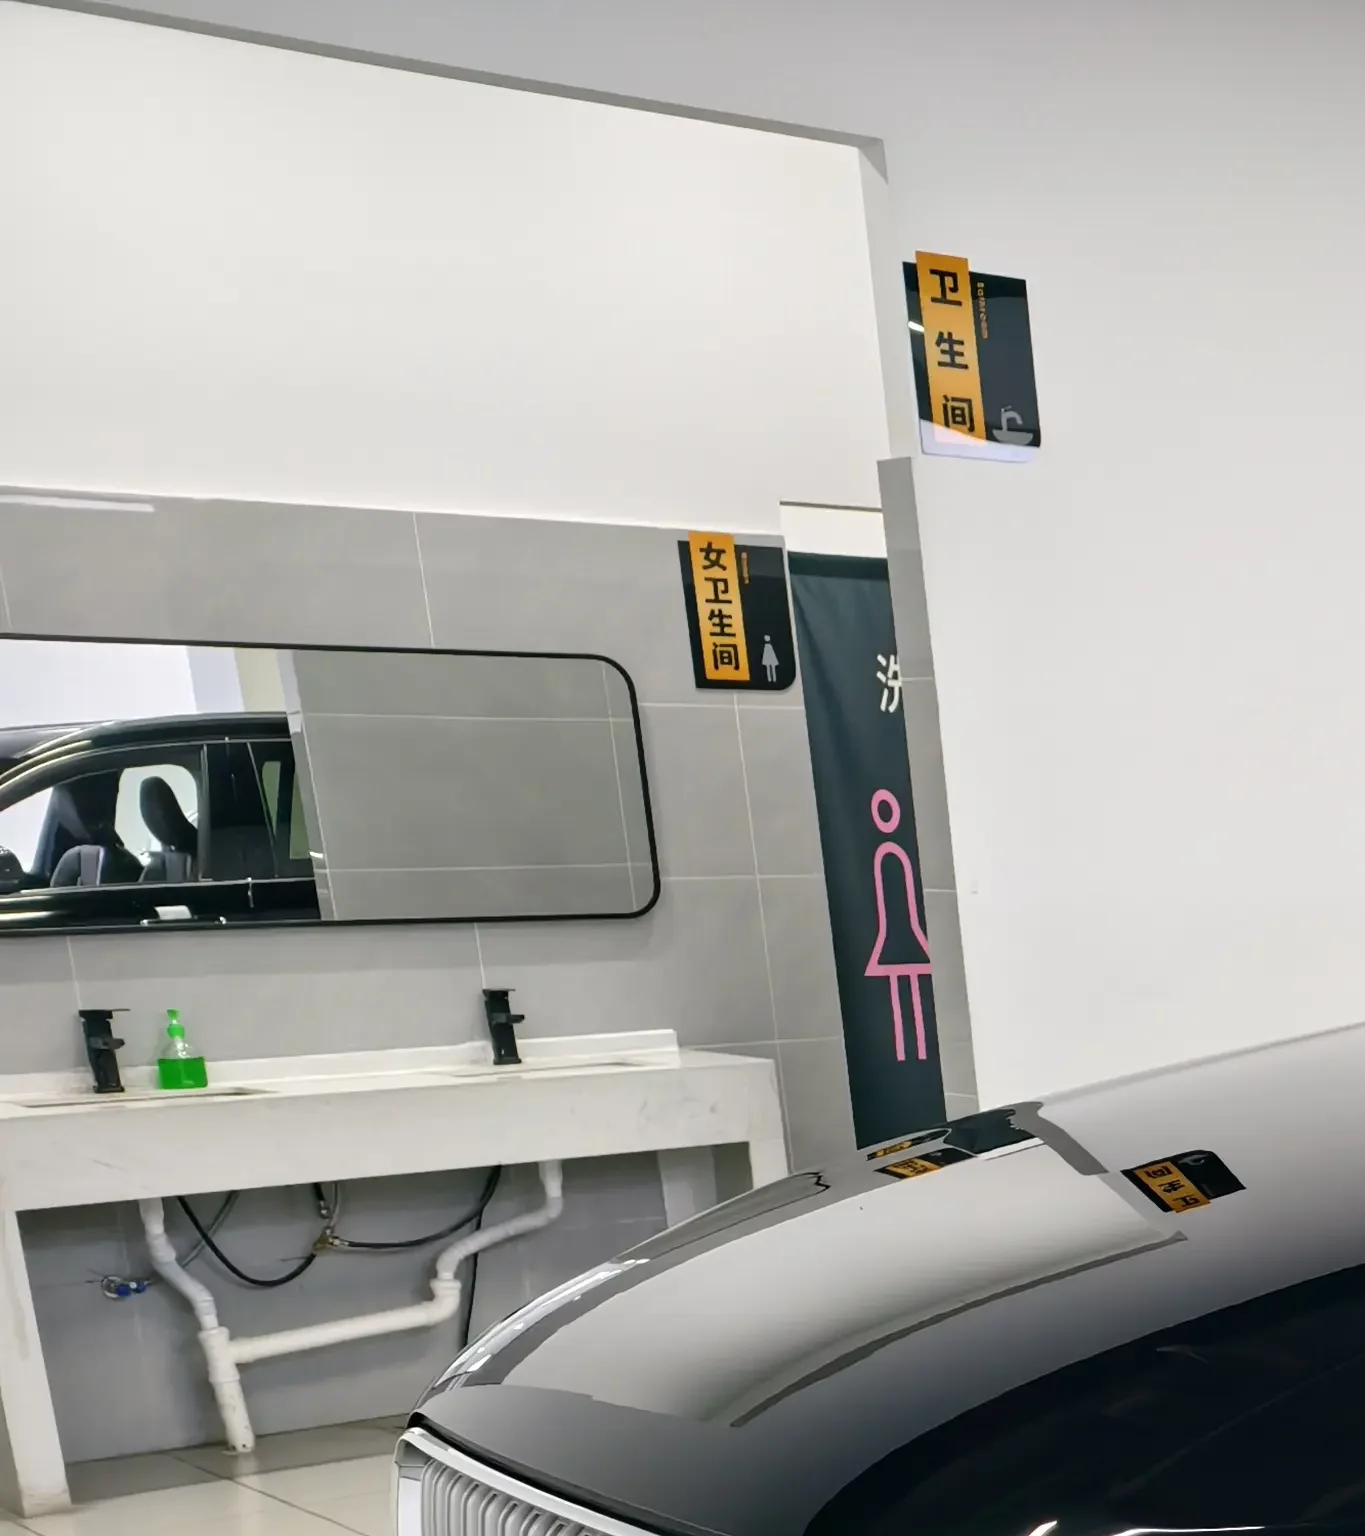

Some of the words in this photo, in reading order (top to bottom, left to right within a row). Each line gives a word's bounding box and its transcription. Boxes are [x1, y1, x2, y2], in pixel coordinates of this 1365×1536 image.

[928, 267, 976, 433] 卫生间
[698, 541, 740, 671] 女卫生间
